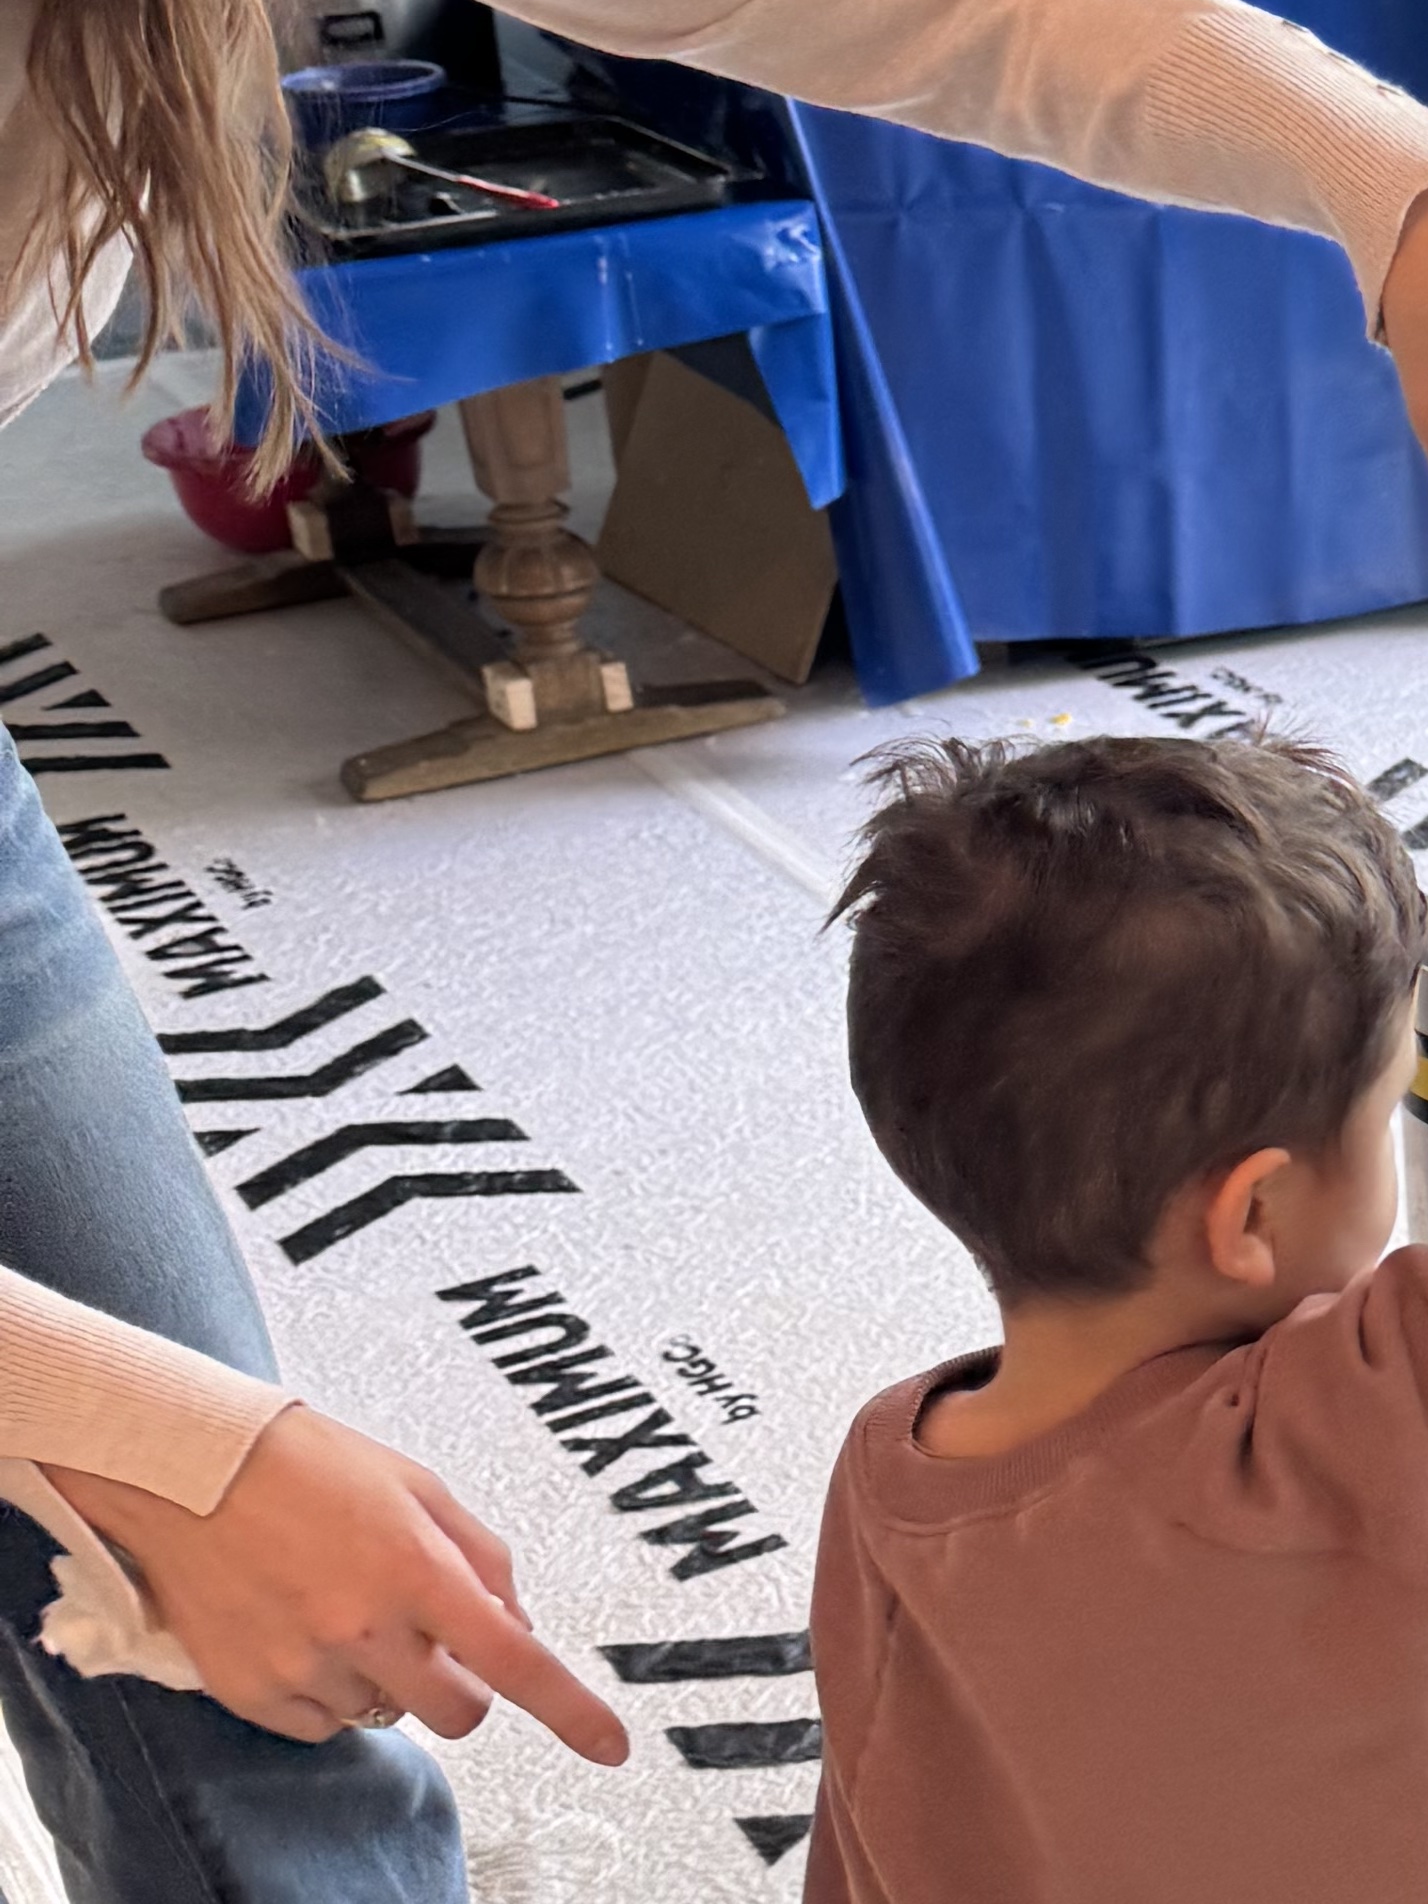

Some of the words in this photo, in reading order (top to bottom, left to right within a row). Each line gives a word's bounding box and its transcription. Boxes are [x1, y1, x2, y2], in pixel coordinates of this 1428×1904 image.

[54, 812, 273, 1003] MAXIMUM
[435, 1262, 789, 1584] MAXIMUM
[710, 1392, 764, 1427] by
